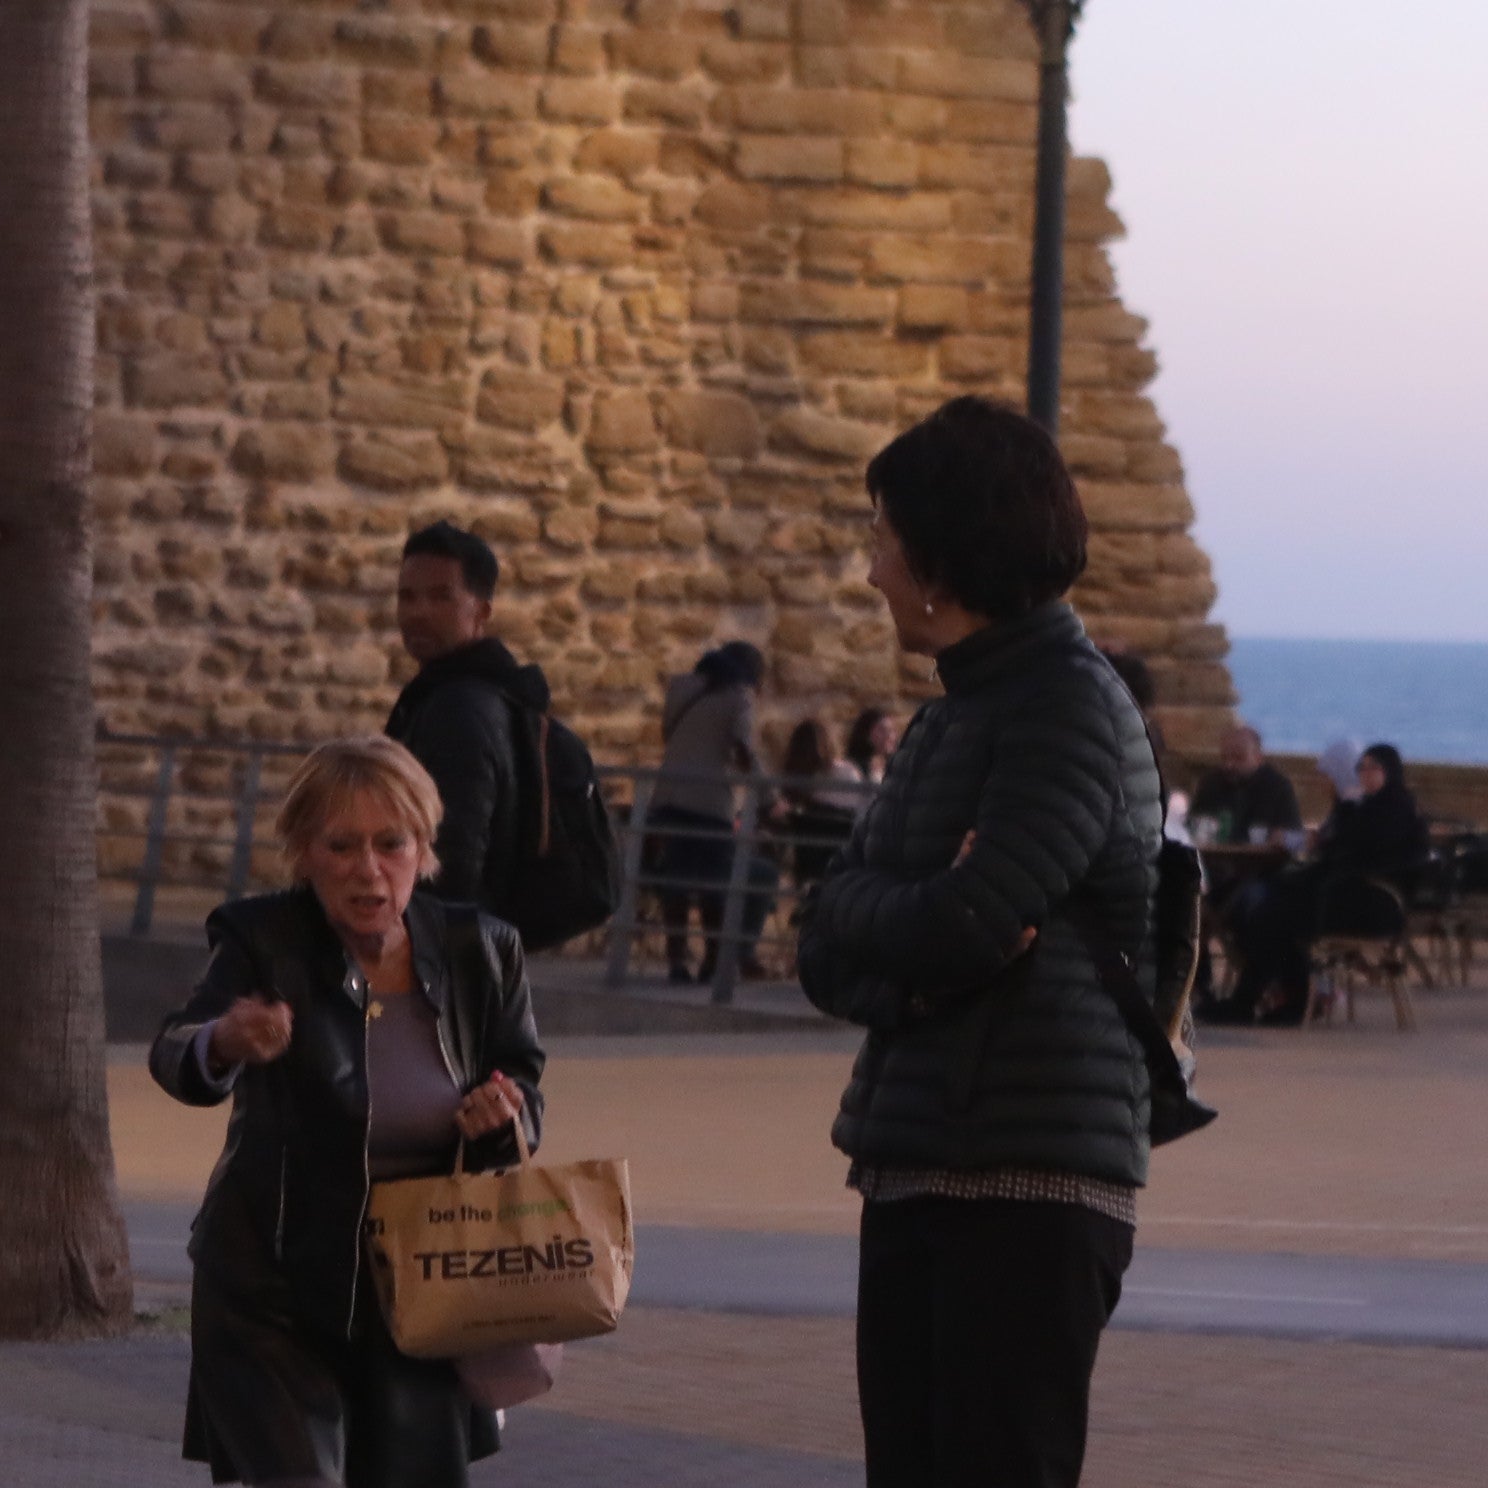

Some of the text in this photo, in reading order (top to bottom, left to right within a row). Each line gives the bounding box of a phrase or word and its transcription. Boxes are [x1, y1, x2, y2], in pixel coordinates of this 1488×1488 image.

[428, 1206, 455, 1225] be
[460, 1204, 493, 1222] the
[413, 1233, 595, 1281] TEZENIS
